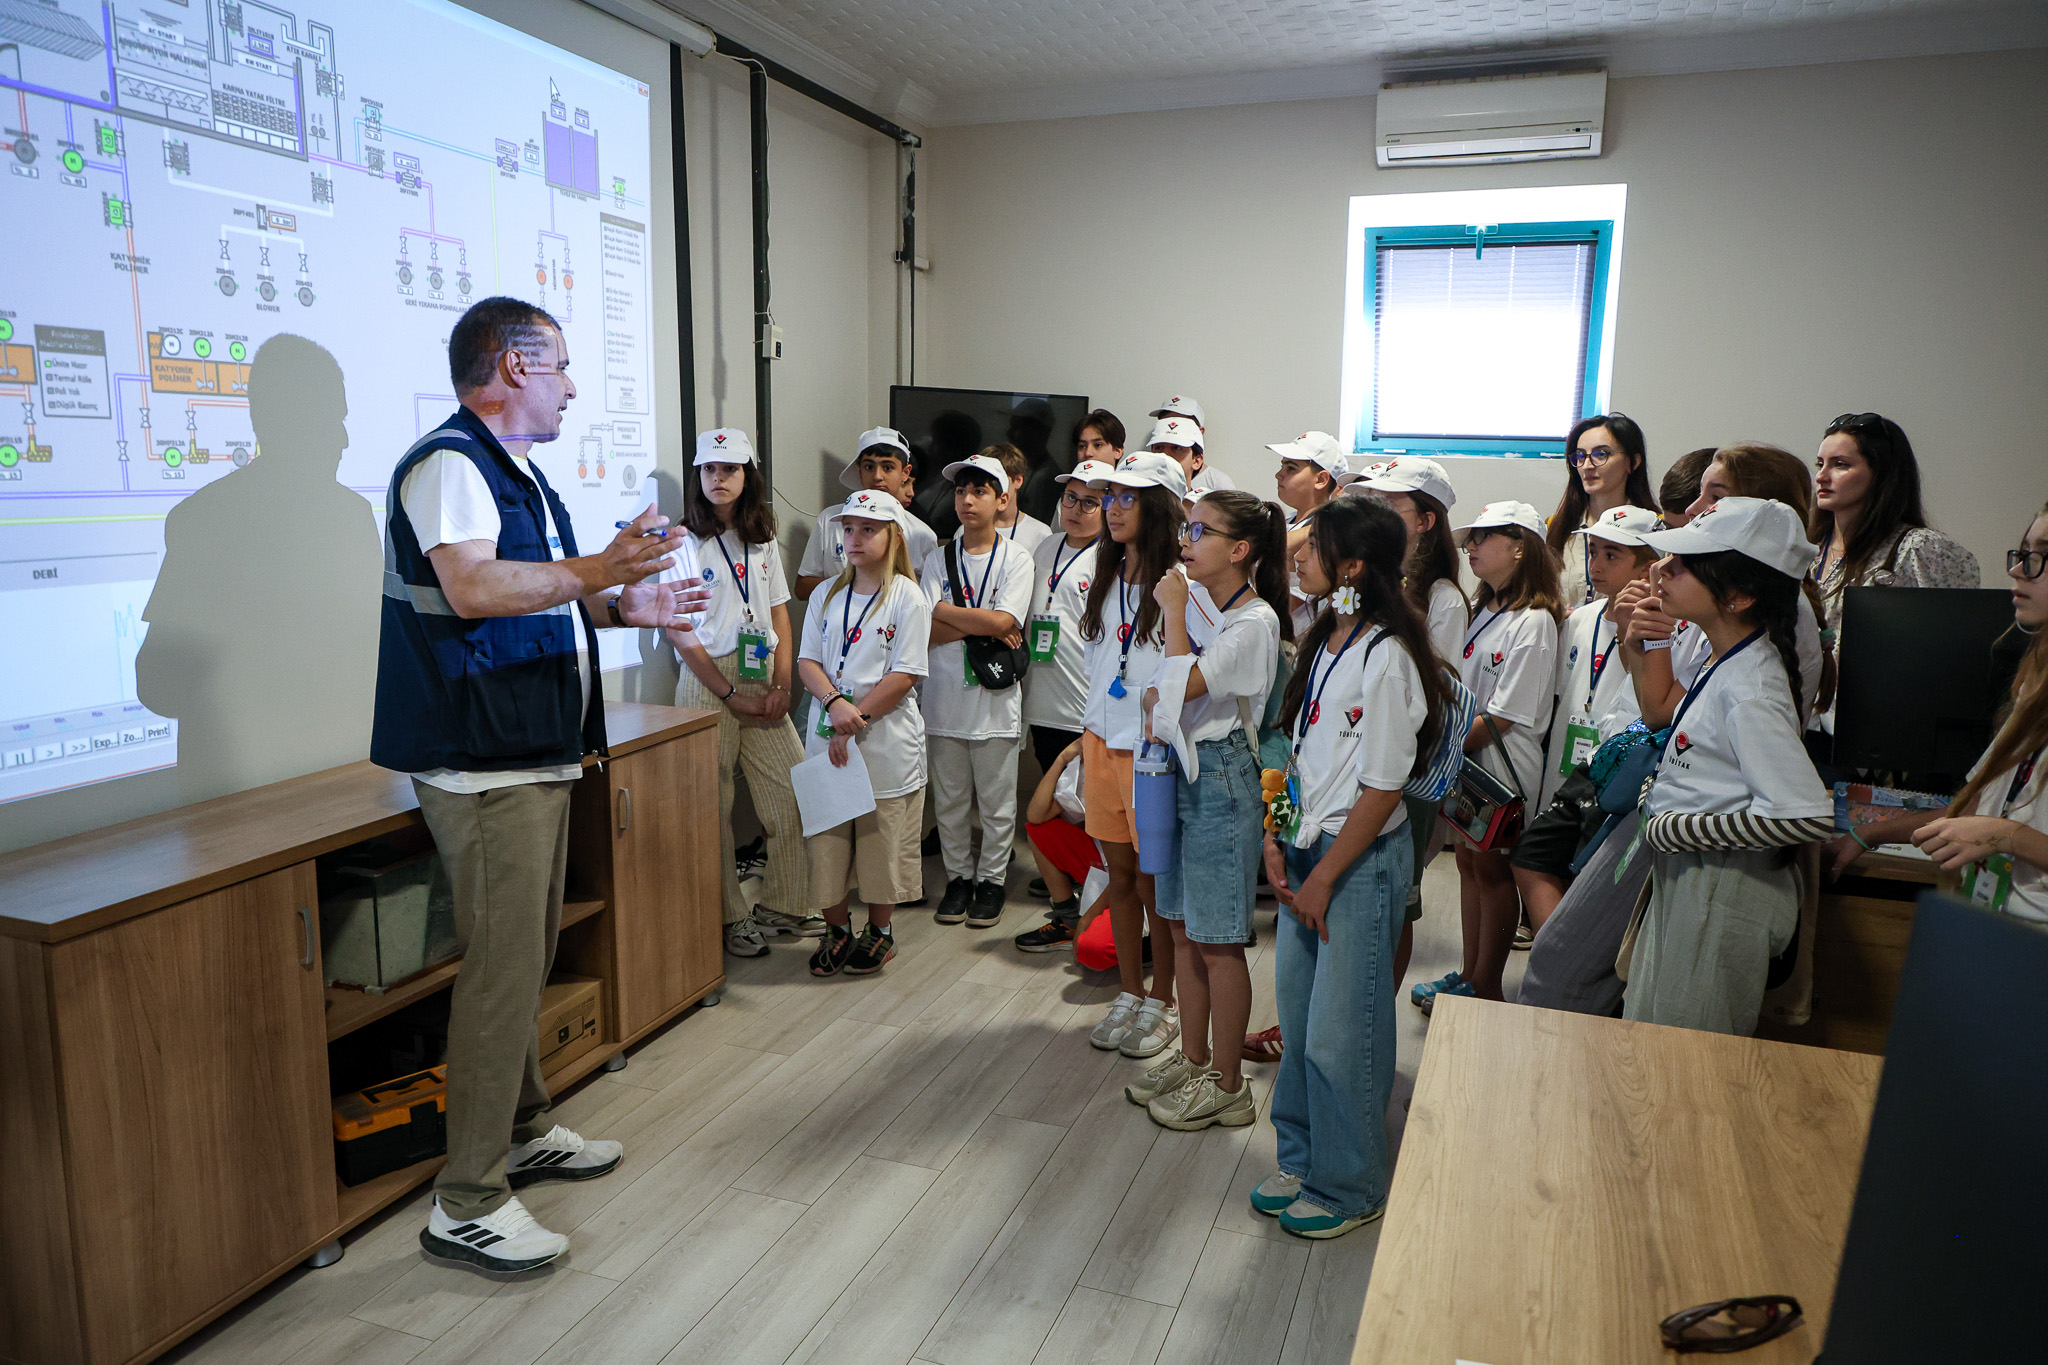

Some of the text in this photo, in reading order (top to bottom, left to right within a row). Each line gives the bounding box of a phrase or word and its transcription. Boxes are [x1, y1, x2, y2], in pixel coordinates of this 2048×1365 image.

[110, 252, 151, 265] KATYONİK
[114, 261, 149, 274] POLİMER
[256, 303, 280, 313] BLOWER
[418, 301, 438, 309] YIKAMA
[155, 364, 194, 374] KATYONİK
[159, 373, 192, 383] POLİMER
[32, 567, 58, 580] DEBİ
[988, 662, 1000, 679] adidas
[148, 725, 170, 738] Print
